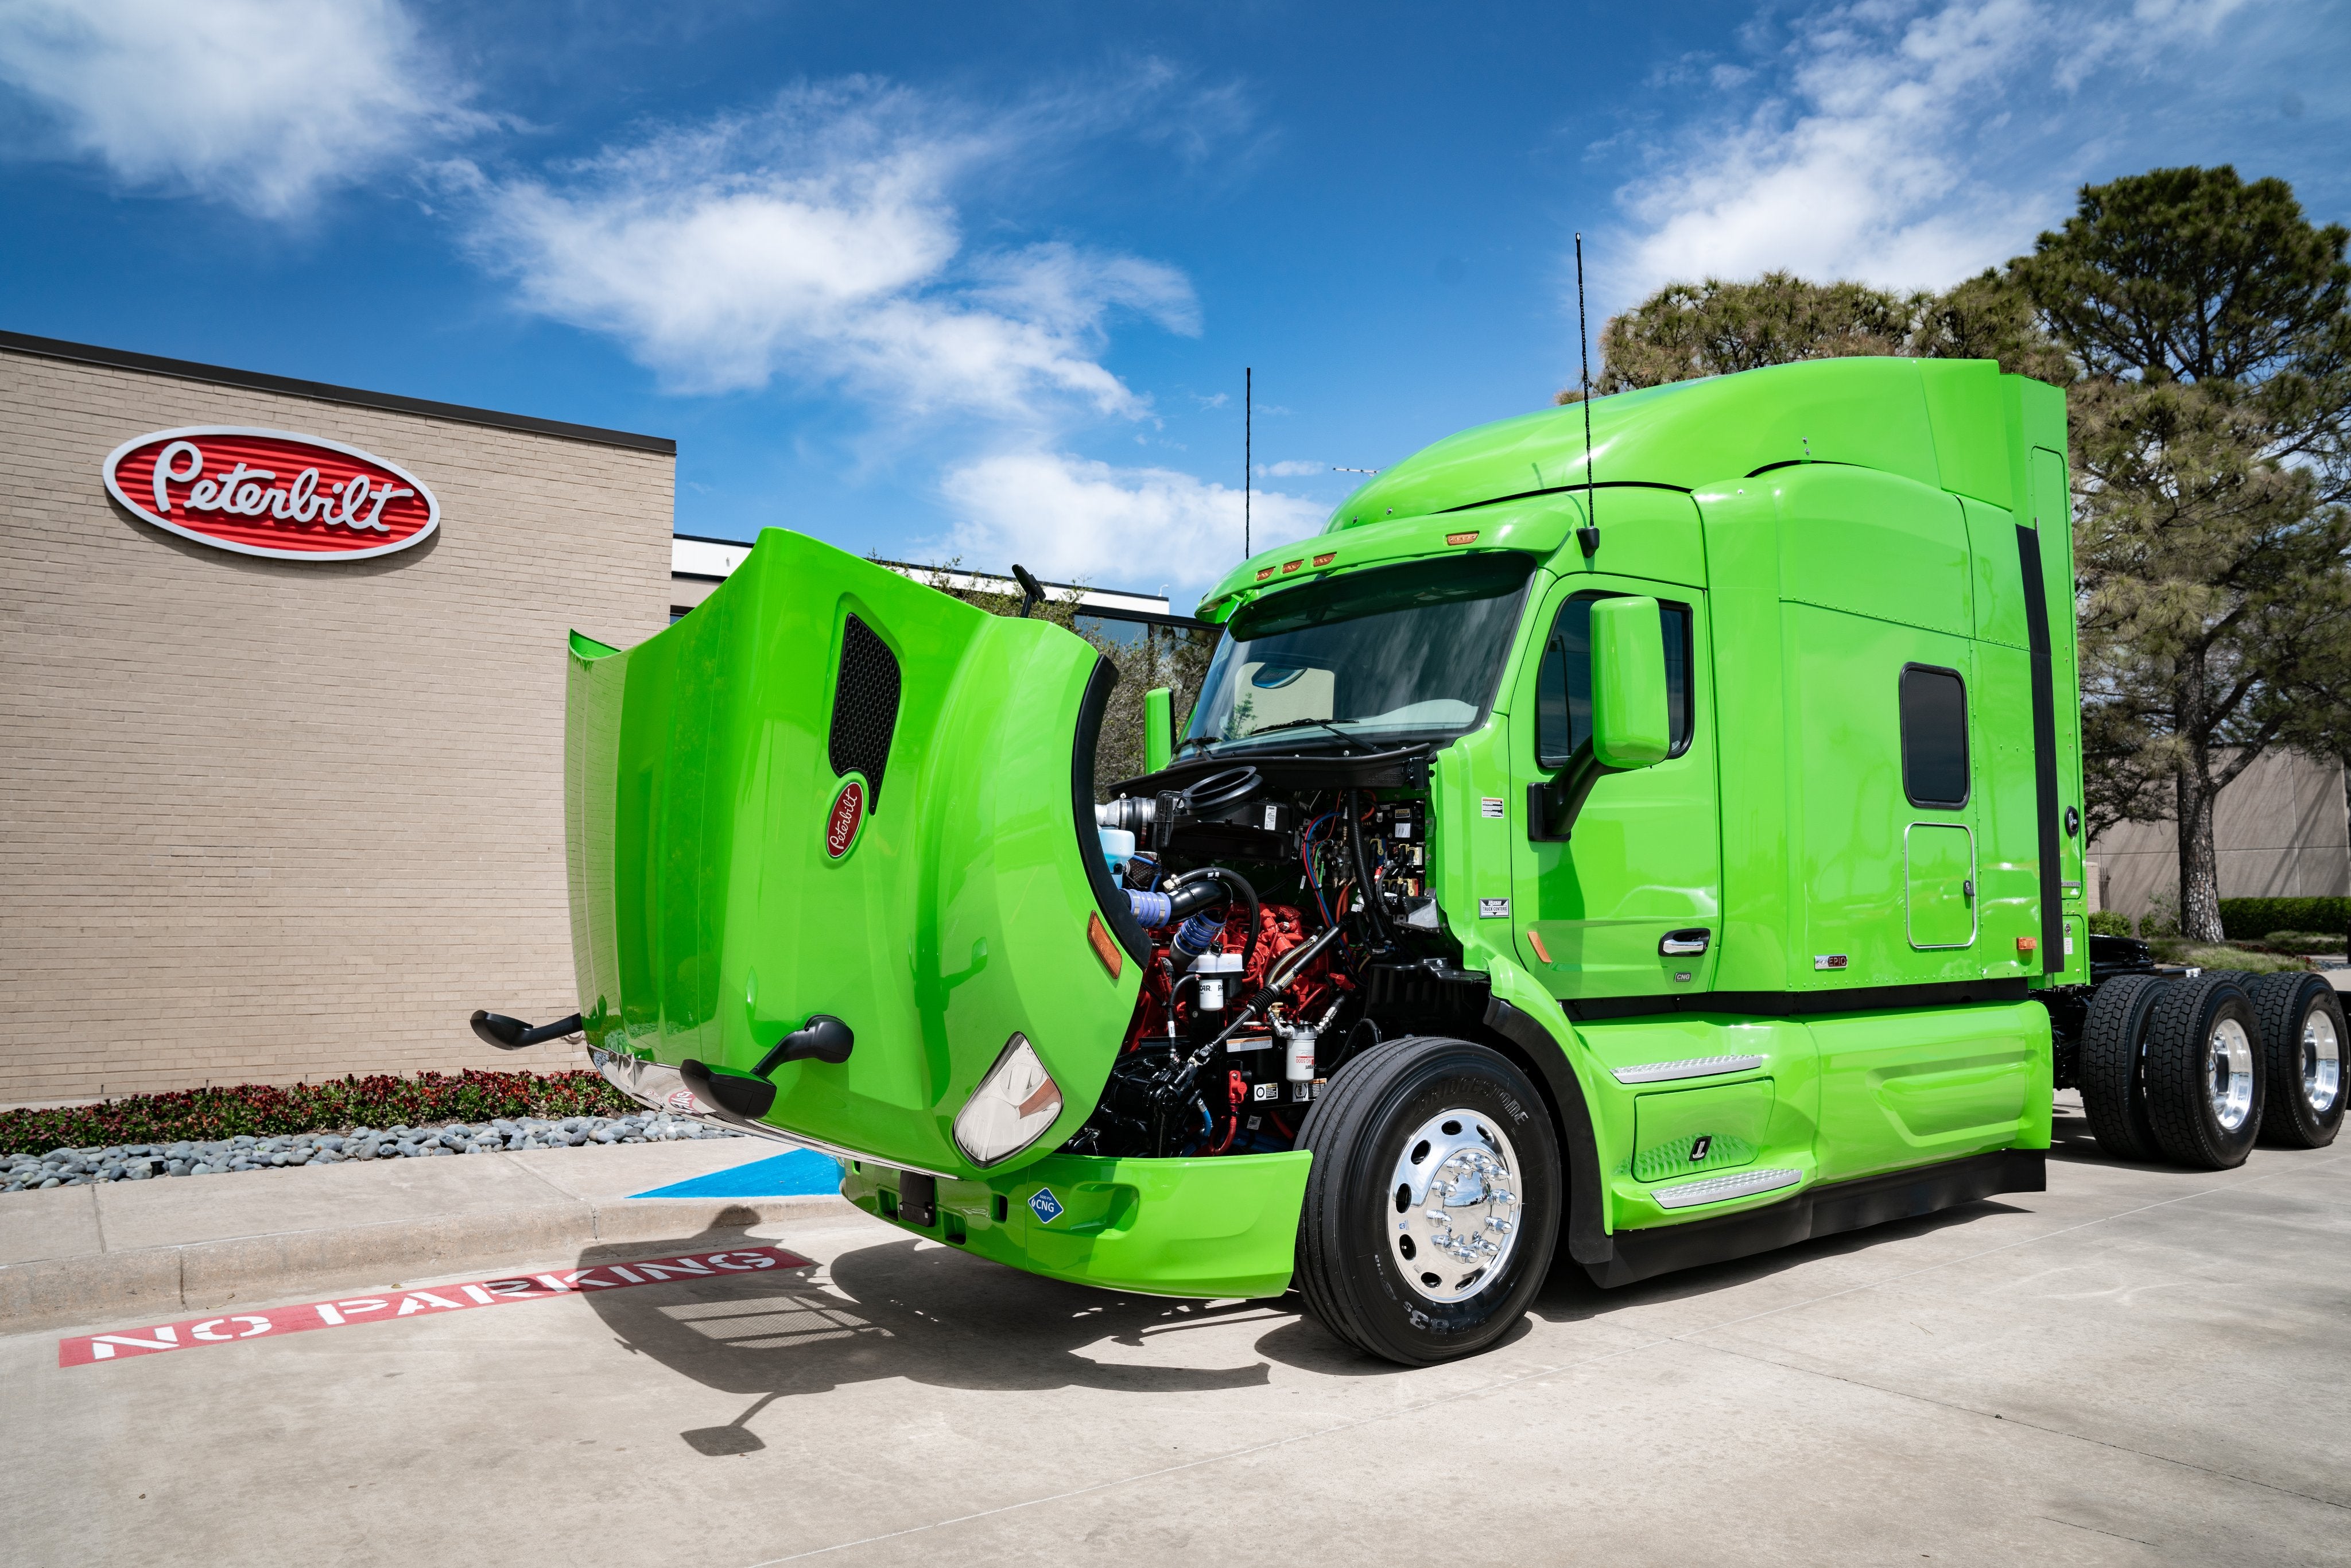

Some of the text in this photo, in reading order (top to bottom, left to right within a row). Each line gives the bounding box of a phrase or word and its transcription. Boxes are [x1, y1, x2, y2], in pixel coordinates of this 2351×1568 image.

[152, 440, 414, 531] Peterbilt
[829, 787, 858, 849] Peterbilt
[1829, 957, 1846, 966] EPIQ
[1413, 1077, 1529, 1125] BRIDGESTONE
[1036, 1199, 1054, 1212] CNG
[90, 1252, 777, 1360] NO PARKING
